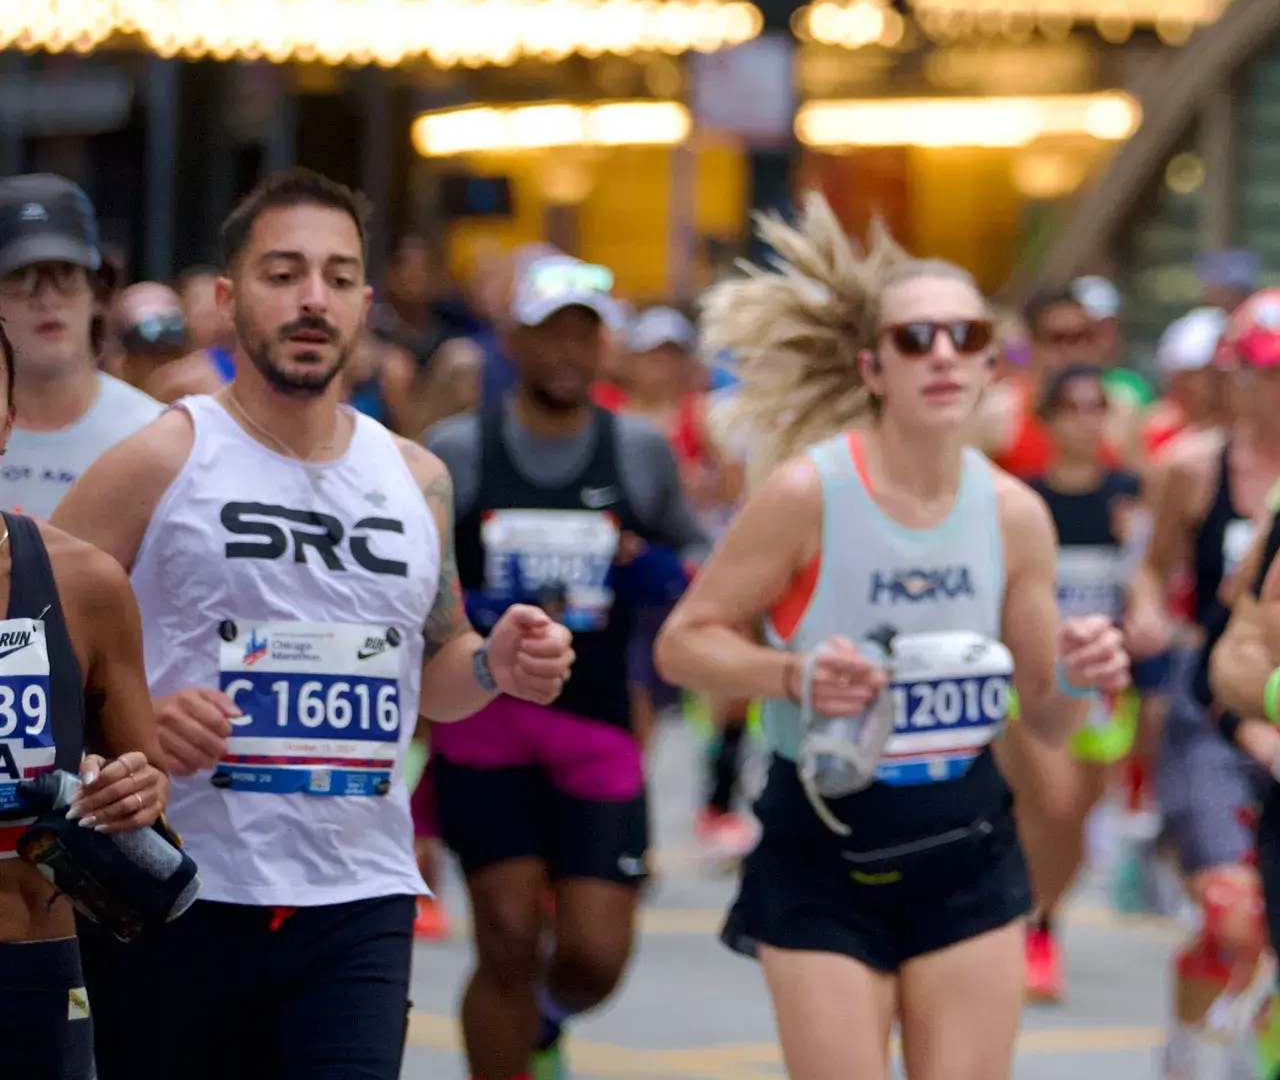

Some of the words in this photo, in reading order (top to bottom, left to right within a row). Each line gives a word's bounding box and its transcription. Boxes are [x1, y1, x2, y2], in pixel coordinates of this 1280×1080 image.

[220, 501, 408, 578] SRC
[870, 566, 974, 603] HOKA
[0, 631, 32, 647] RUN
[224, 678, 255, 726] C
[271, 680, 400, 733] 16616
[893, 676, 1009, 730] 12010
